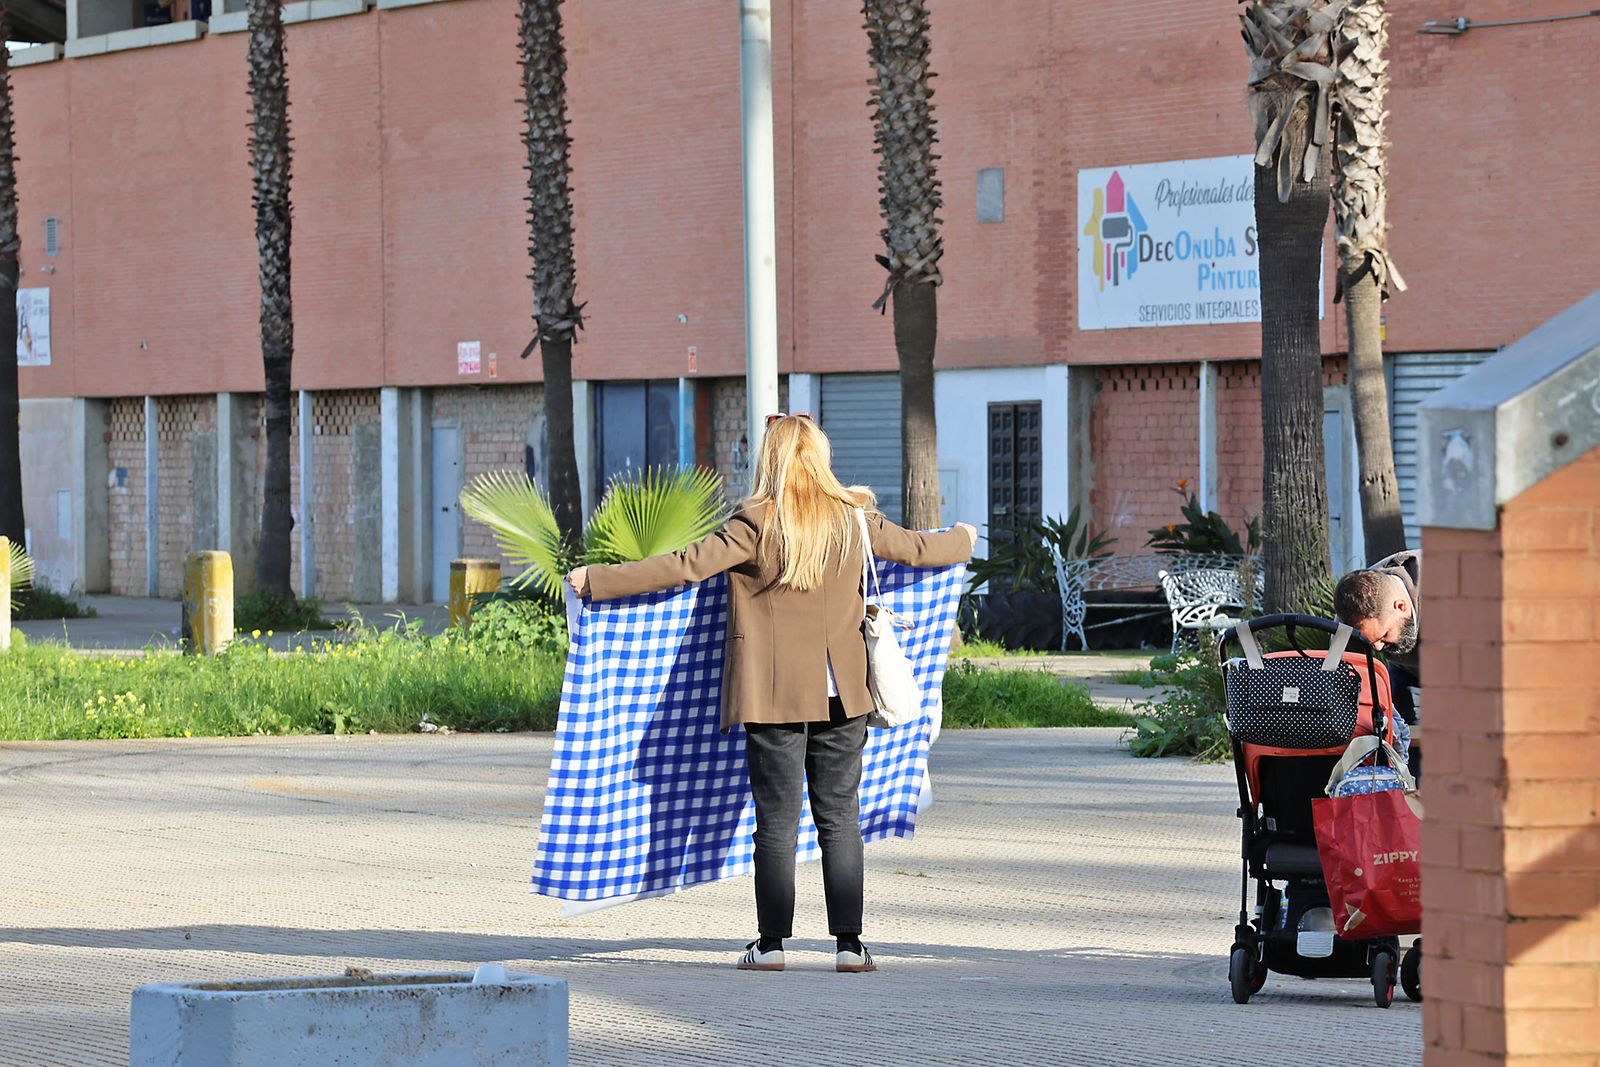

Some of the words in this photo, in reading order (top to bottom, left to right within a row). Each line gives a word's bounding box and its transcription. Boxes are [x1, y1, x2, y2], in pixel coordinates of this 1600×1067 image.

[1155, 177, 1233, 217] Profesionales
[1139, 302, 1191, 322] SERVICIOS
[1196, 299, 1258, 320] INTEGRALES
[1373, 850, 1418, 865] ZIPPY
